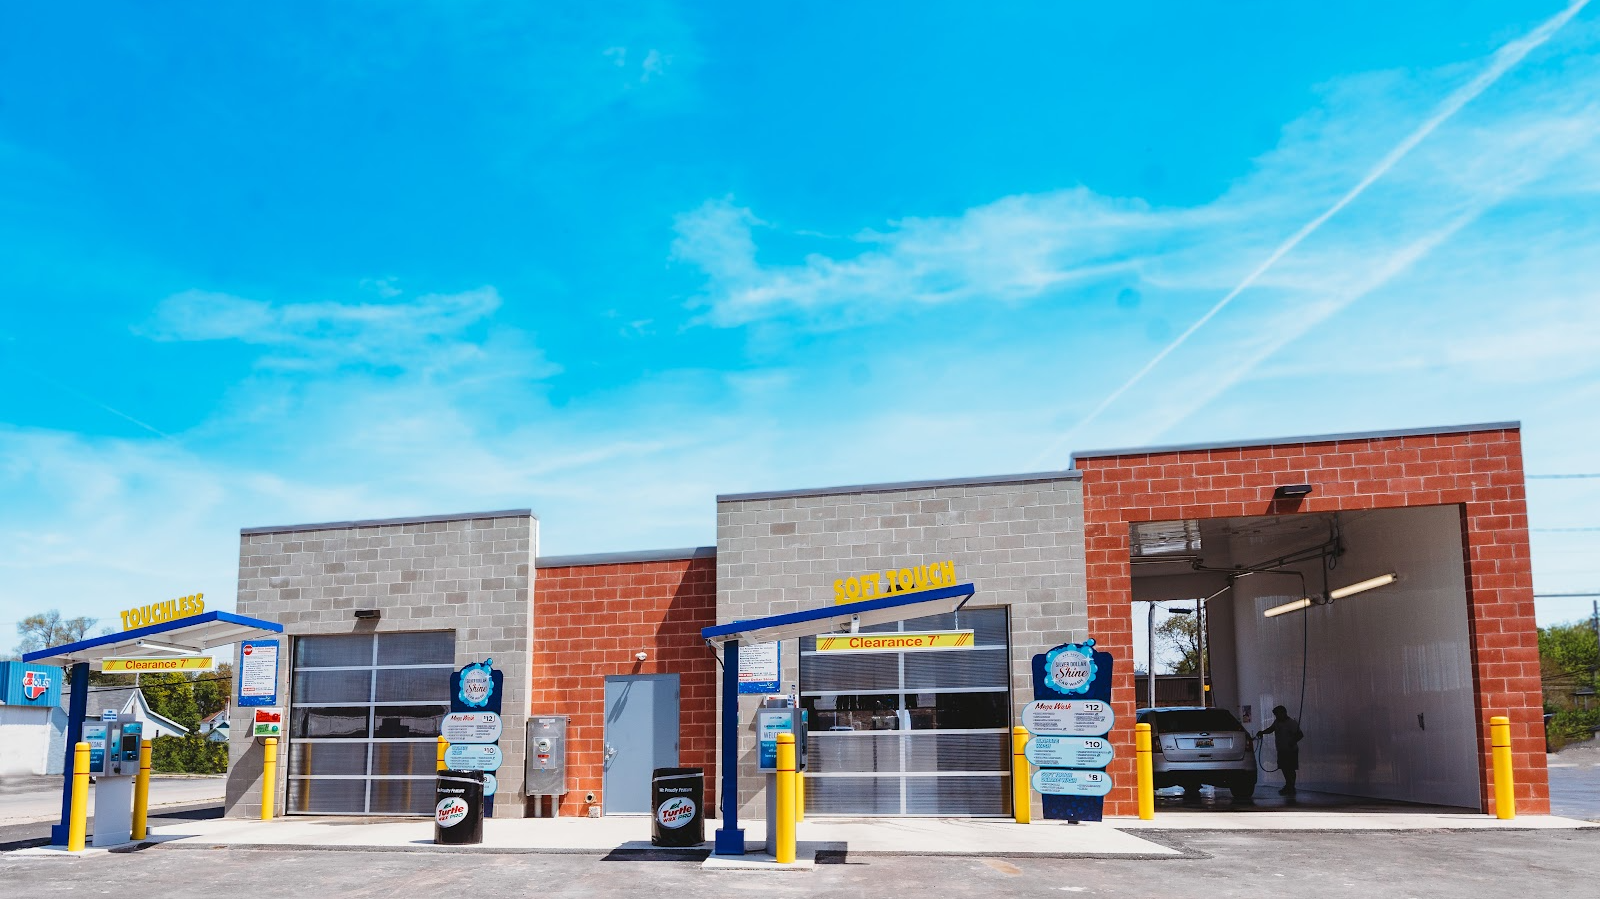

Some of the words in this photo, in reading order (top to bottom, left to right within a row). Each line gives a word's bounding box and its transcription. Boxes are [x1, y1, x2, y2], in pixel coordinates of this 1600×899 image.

[833, 573, 881, 602] SOFT
[886, 560, 957, 594] TOUCH
[120, 592, 204, 630] TOUCHLESS
[849, 637, 923, 648] Clearance
[927, 635, 940, 646] 7'
[125, 660, 177, 670] Clearance
[180, 658, 190, 668] 7'
[1055, 665, 1088, 679] Shine
[466, 683, 487, 693] Shine
[1053, 702, 1072, 710] Wash
[1089, 773, 1098, 781] $8
[438, 805, 464, 817] Turtle
[662, 805, 692, 818] Turtle
[677, 812, 692, 820] PRO
